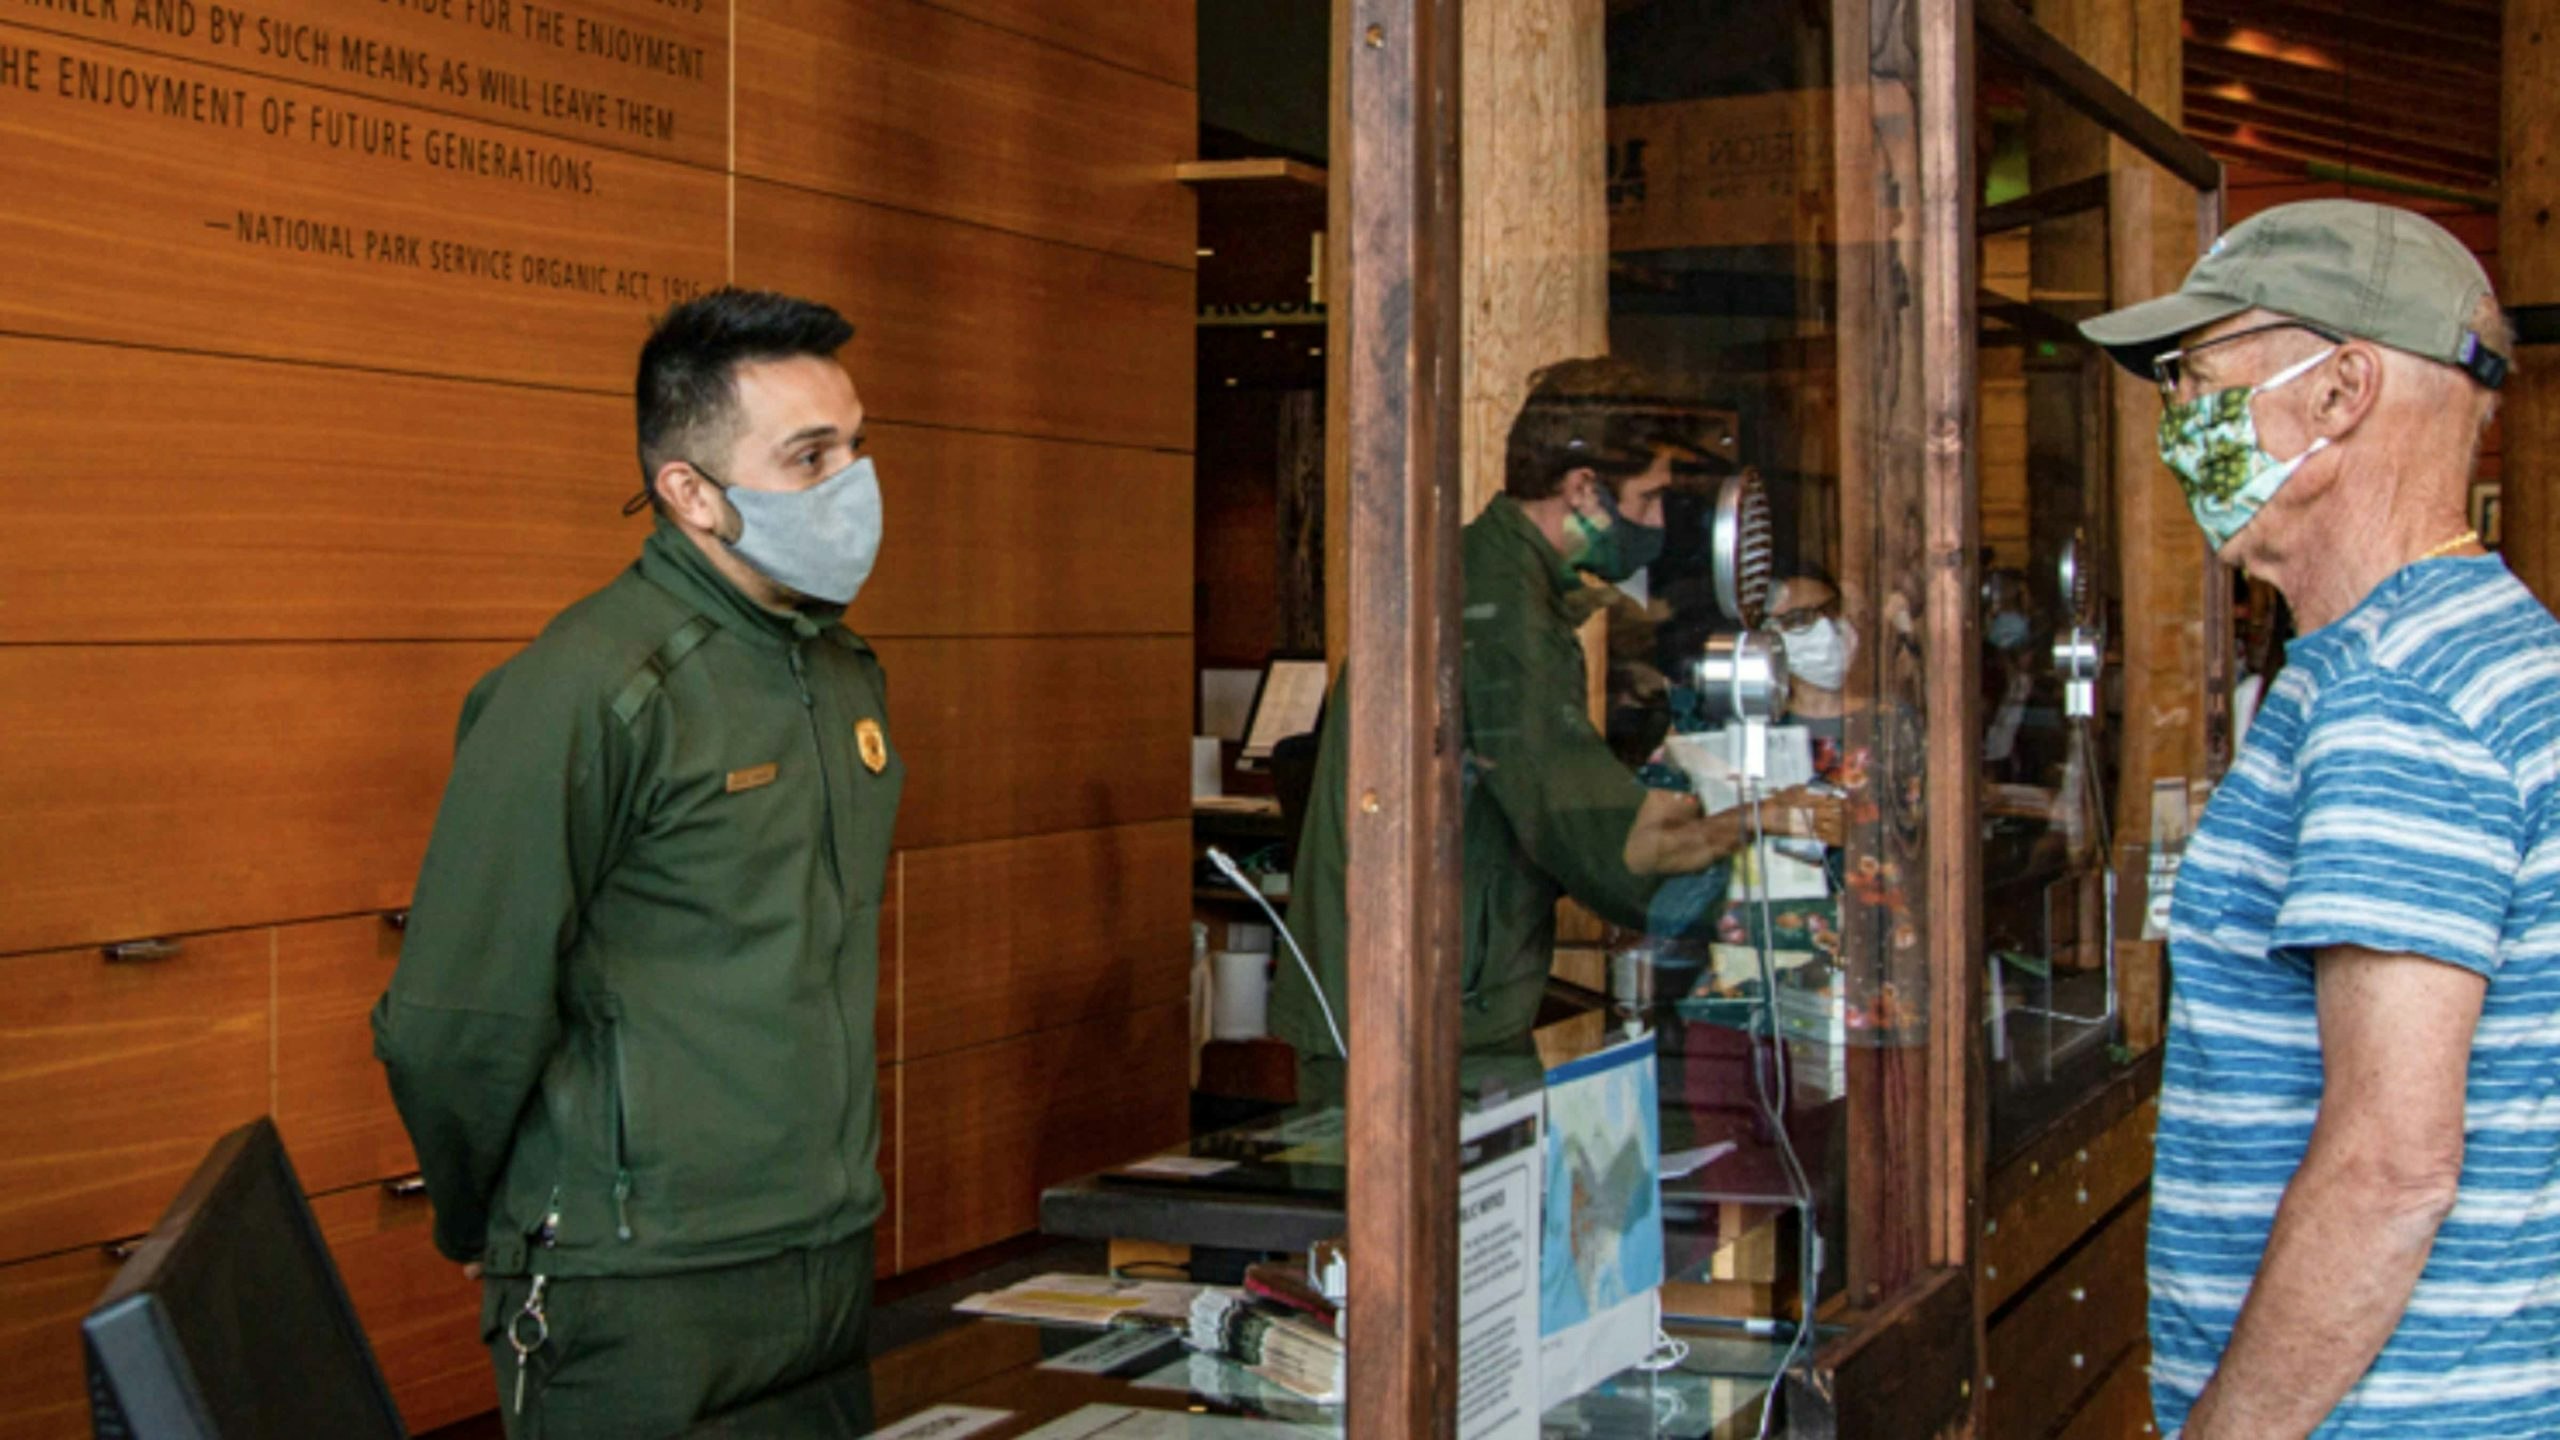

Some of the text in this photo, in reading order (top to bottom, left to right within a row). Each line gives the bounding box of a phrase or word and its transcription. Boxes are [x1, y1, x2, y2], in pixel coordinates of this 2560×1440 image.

[131, 0, 196, 38] AND
[209, 4, 247, 47] BY
[256, 16, 330, 66] SUCH
[338, 35, 430, 92] MEANS
[439, 59, 469, 97] AS
[478, 68, 531, 112] WILL
[541, 82, 607, 130] LEAVE
[616, 98, 675, 141] THEM
[466, 0, 512, 34] FOR
[523, 4, 564, 47] THE
[576, 18, 704, 82] ENJOYMENT
[0, 46, 603, 196] HE ENJOYMENT OF FUTURE GENERATIONS.
[364, 230, 421, 267] PARK
[429, 240, 513, 282] SERVICE
[521, 255, 609, 296] ORGANIC
